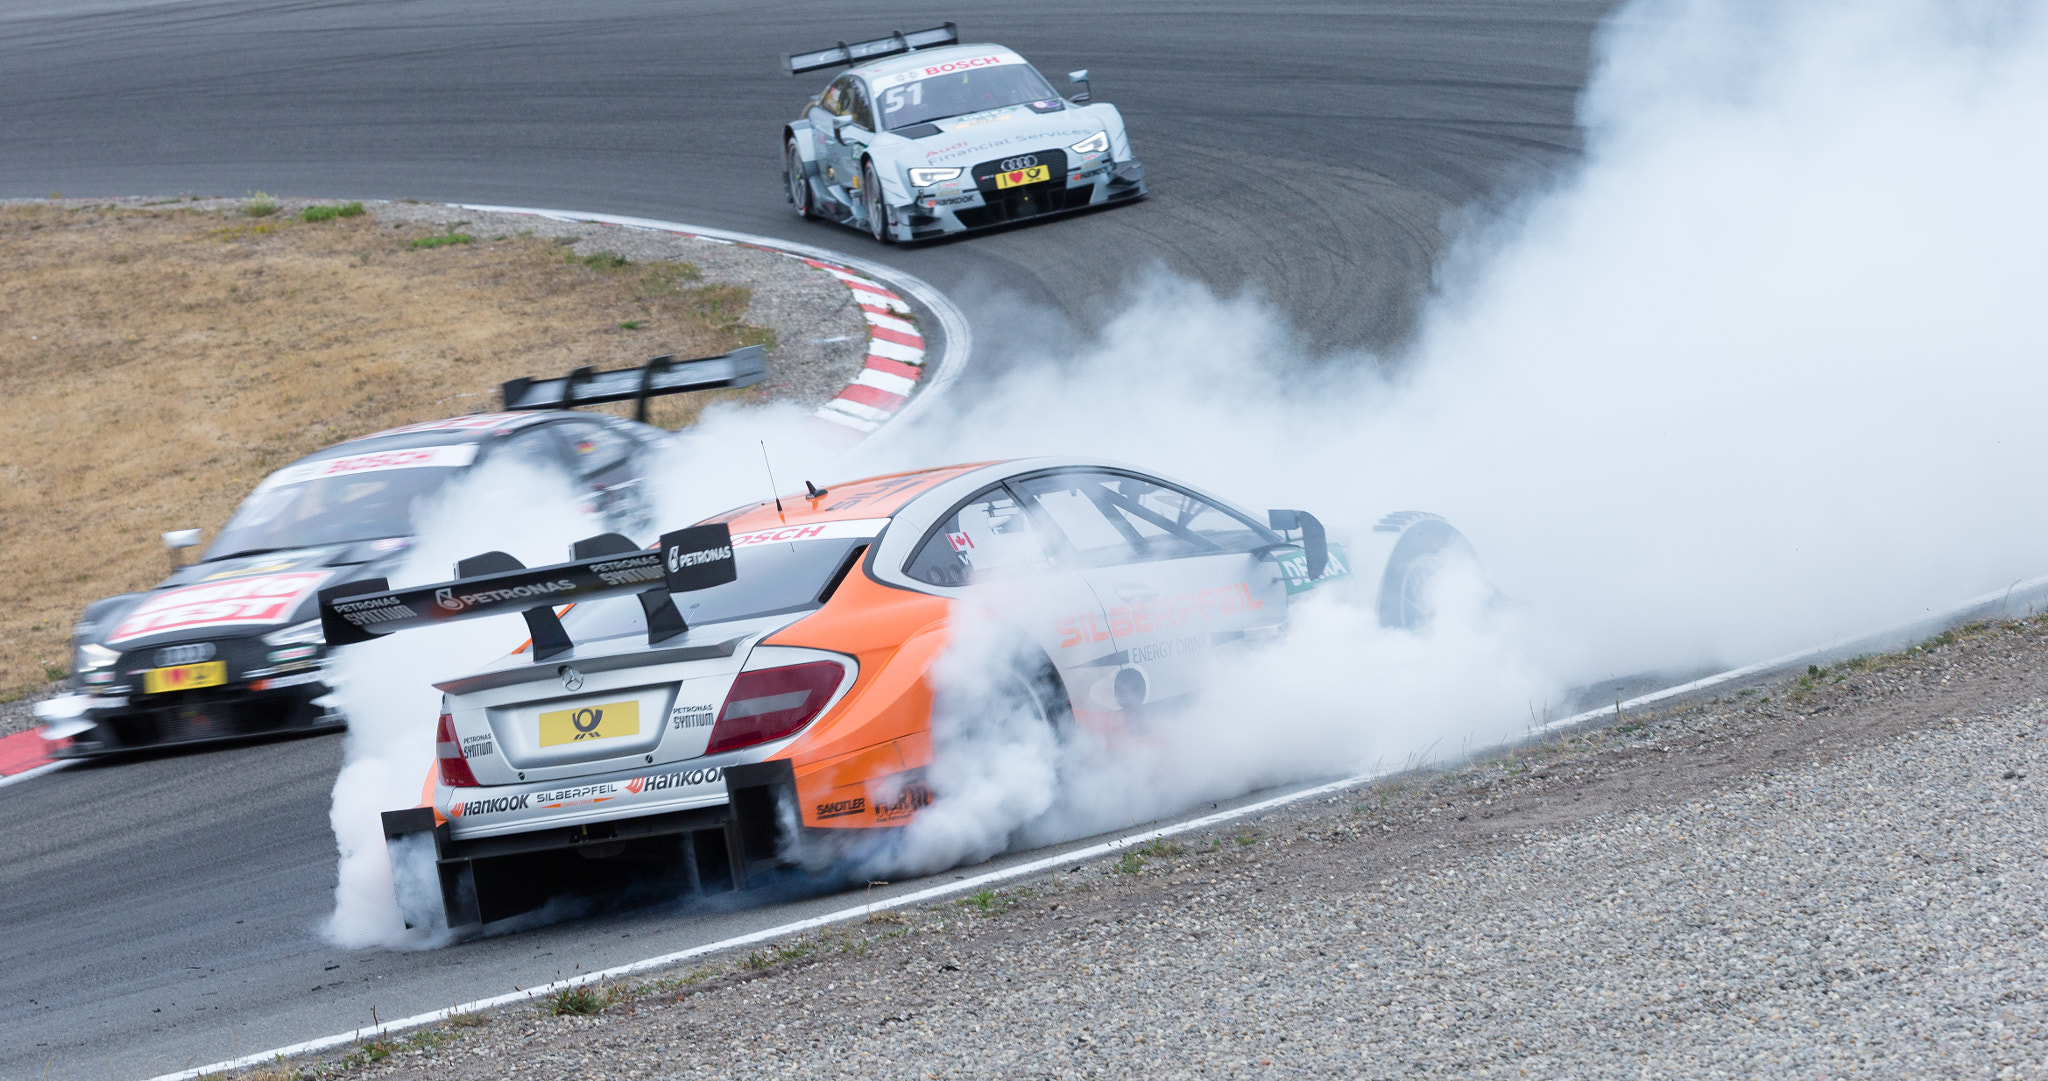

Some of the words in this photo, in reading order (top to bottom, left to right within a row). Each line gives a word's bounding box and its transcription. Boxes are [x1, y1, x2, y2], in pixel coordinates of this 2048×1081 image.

[924, 56, 1000, 76] BOSCH
[885, 82, 922, 114] 51
[925, 140, 969, 159] Audi
[927, 138, 1012, 167] Financial
[1015, 128, 1093, 142] Services
[731, 525, 827, 547] OSCH
[589, 555, 661, 574] PETRONAS
[679, 545, 732, 569] PETRONAS
[460, 579, 577, 605] PETRONAS
[333, 596, 401, 614] PETRONAS
[1055, 582, 1264, 648] SILBERPFEIL
[343, 605, 418, 626] SYNTIUM
[1132, 638, 1174, 664] ENERGY
[673, 704, 713, 715] PETRONAS
[673, 712, 715, 730] SYNTIUM
[463, 733, 492, 744] PETRONAS
[463, 741, 494, 759] SYNTIUM
[536, 783, 618, 803] SILBERPFEIL
[816, 797, 865, 815] SANDTLER
